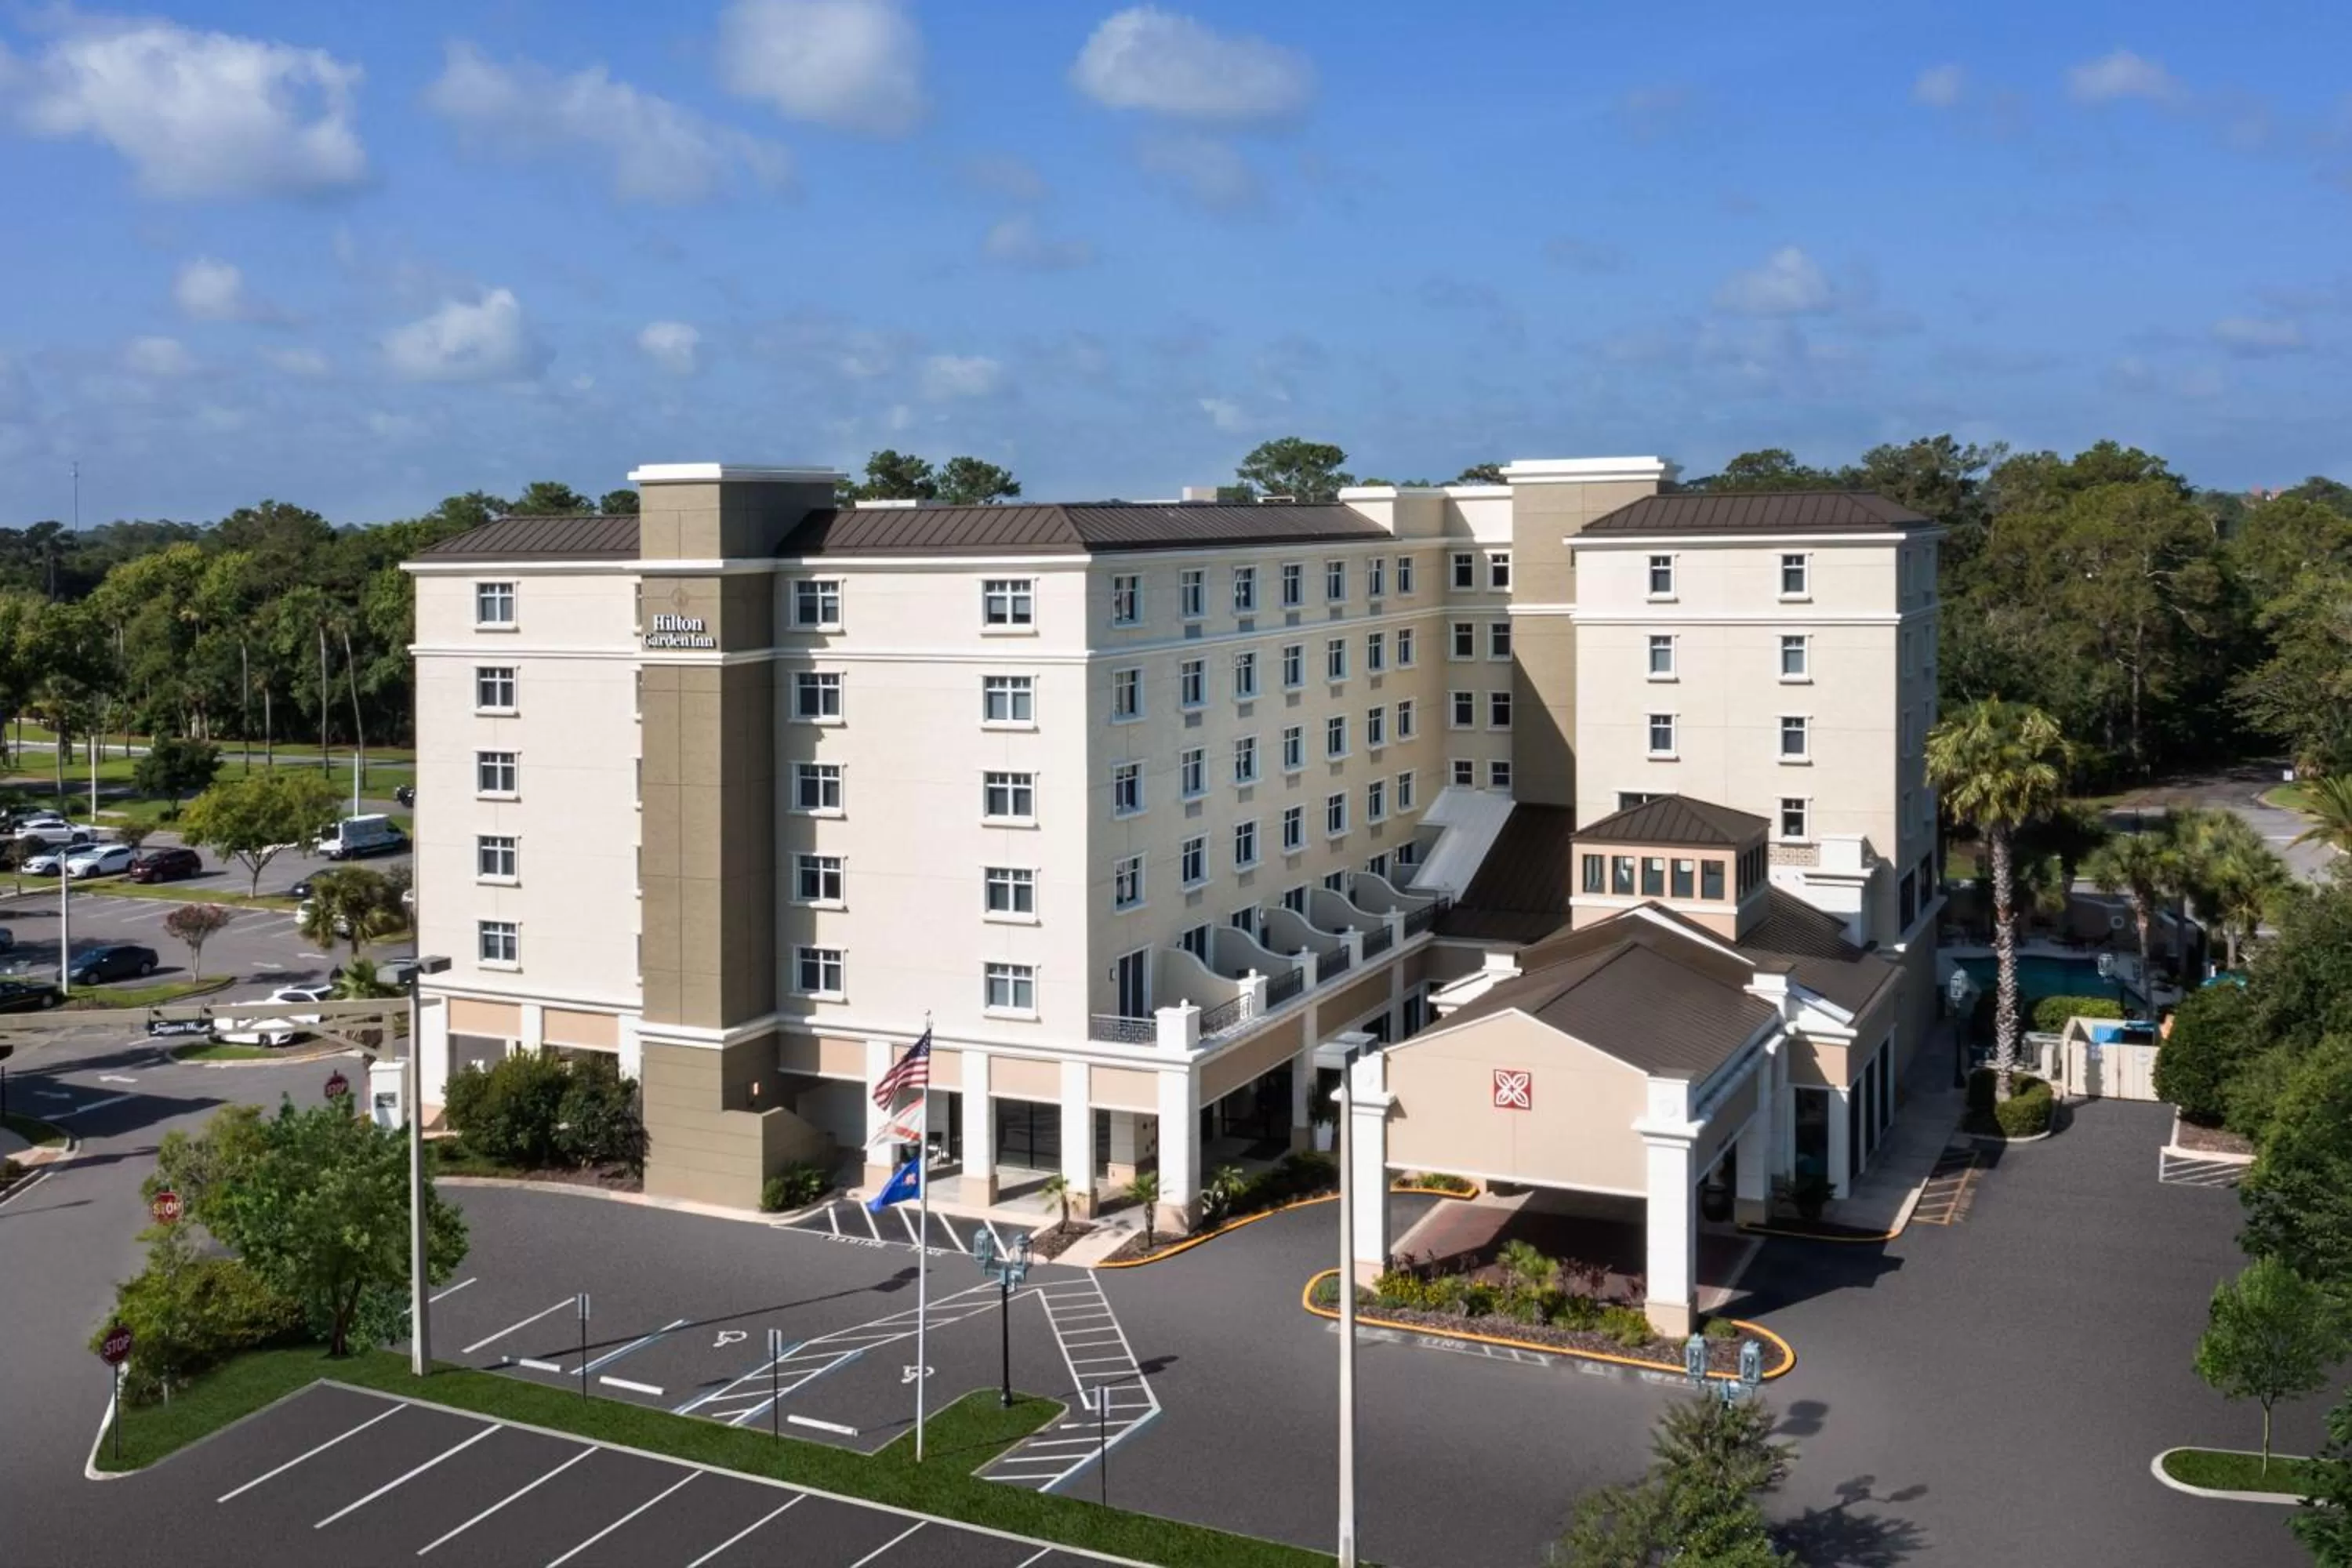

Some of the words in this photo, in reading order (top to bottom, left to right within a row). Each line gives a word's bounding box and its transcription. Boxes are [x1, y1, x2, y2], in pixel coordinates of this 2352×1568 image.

[653, 614, 703, 631] Hilton
[643, 633, 690, 647] Garden
[691, 633, 715, 647] Inn
[104, 1334, 130, 1356] STOP
